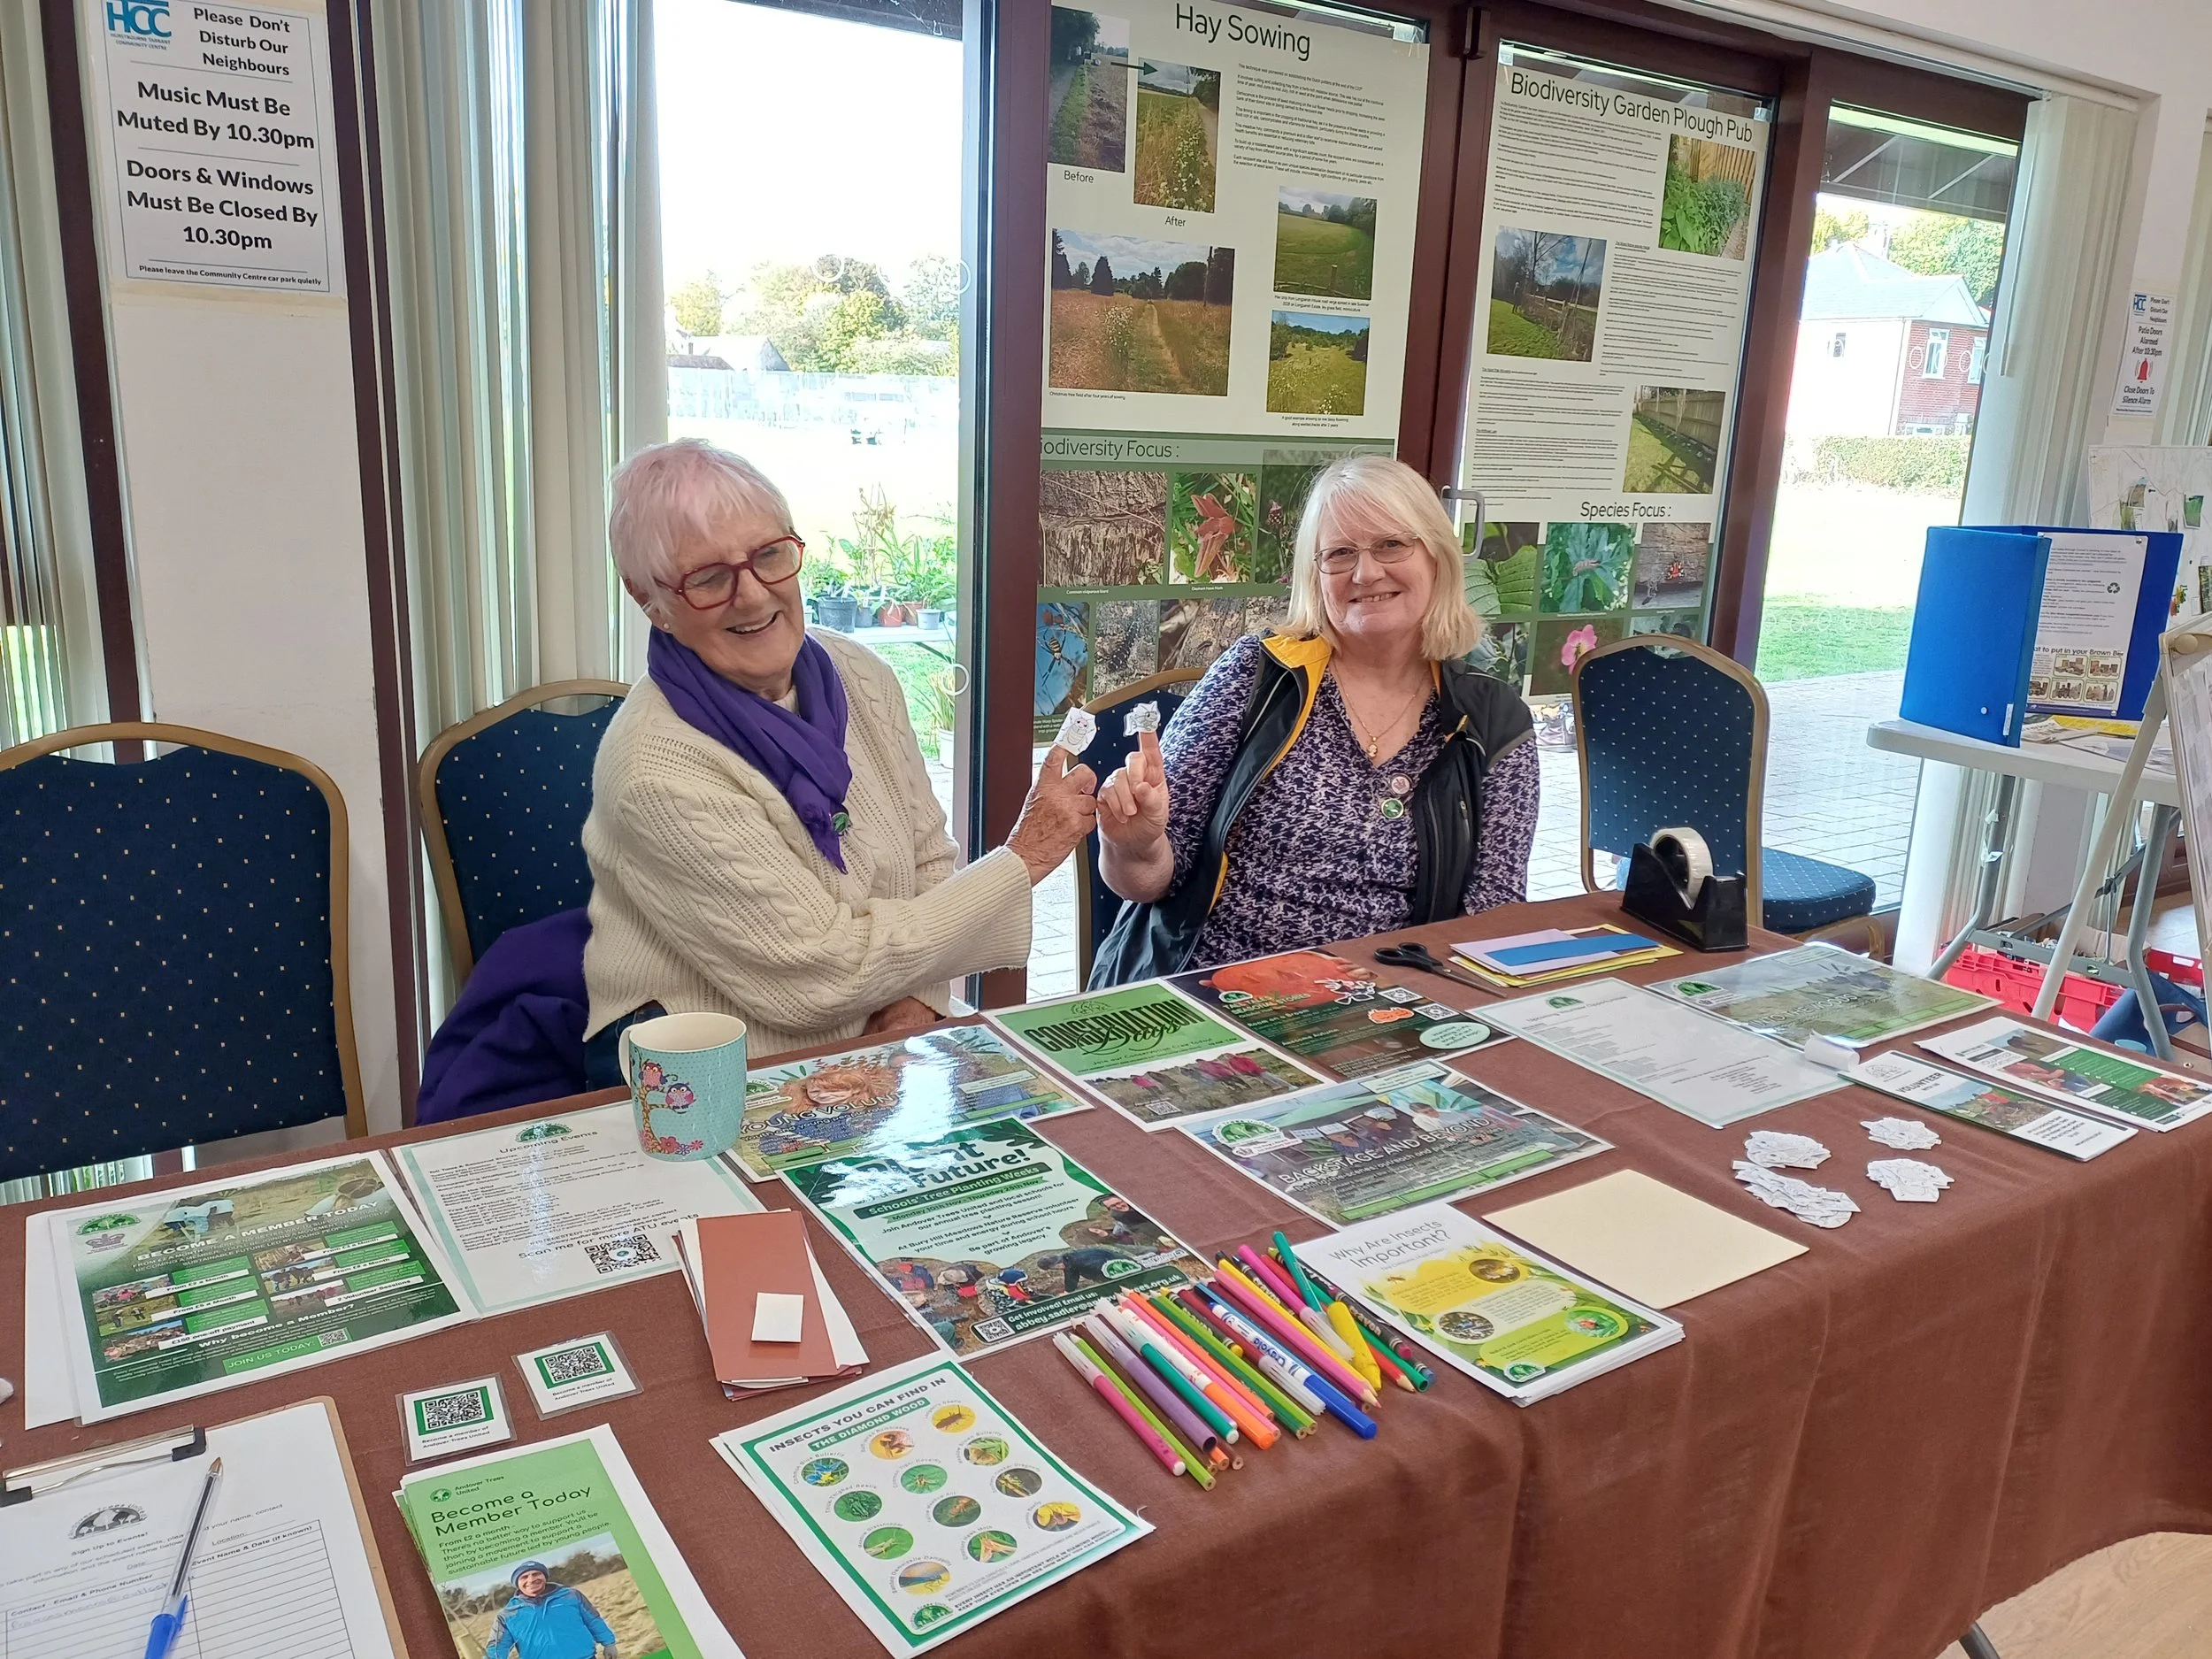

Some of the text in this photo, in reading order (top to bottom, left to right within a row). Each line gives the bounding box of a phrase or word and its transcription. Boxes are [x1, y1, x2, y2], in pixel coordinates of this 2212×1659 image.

[106, 1, 172, 37] HCC
[194, 6, 291, 33] Please Don't
[1176, 3, 1311, 61] Hay Sowing
[199, 31, 288, 54] Disturb Our
[203, 53, 290, 76] Neighbours
[137, 81, 291, 116] Music Must Be
[1510, 72, 1753, 142] Biodiversity Garden Plough Pub
[117, 111, 315, 149] Muted By 10.30pm
[127, 160, 314, 195] Doors & Windows
[1064, 170, 1094, 184] Before
[127, 190, 318, 227] Must Be Closed By
[1164, 216, 1187, 228] After
[183, 227, 273, 250] 10.30pm
[199, 270, 242, 280] Community
[280, 275, 296, 284] park
[1041, 437, 1123, 460] iodiversity
[1127, 441, 1172, 458] Focus
[1580, 502, 1630, 521] Species
[1632, 503, 1665, 517] Focus
[1024, 999, 1206, 1052] CONSERVATION
[1787, 1003, 1815, 1018] THE
[1895, 1071, 1946, 1094] VOLUNTEER
[740, 1110, 817, 1134] YOUNG
[500, 1132, 598, 1153] Upcoming Events
[1279, 1117, 1491, 1186] BACKSTAGE AND BEYOND
[868, 1167, 1041, 1215] Schools' Tree Planting Weeks
[882, 1225, 900, 1234] Join
[901, 1217, 935, 1229] Andover
[937, 1210, 959, 1219] Trees
[960, 1202, 989, 1214] United
[1003, 1194, 1021, 1202] local
[1023, 1186, 1052, 1197] schools
[910, 1238, 930, 1250] Bury
[931, 1234, 943, 1243] Hill
[944, 1225, 983, 1240] Meadows
[983, 1217, 1010, 1228] Nature
[1011, 1209, 1042, 1221] Reserve
[1043, 1197, 1079, 1212] volunteer
[137, 1237, 221, 1261] BECOME
[225, 1232, 237, 1241] A
[241, 1211, 320, 1239] MEMBER
[318, 1201, 380, 1220] TODAY
[518, 1247, 551, 1259] Scan
[599, 1230, 630, 1240] more
[633, 1223, 657, 1233] ATU
[1329, 1221, 1442, 1261] Why Are Insects
[1349, 1229, 1451, 1268] Important?
[198, 1338, 227, 1348] Why
[231, 1323, 283, 1340] become
[297, 1303, 354, 1322] Member?
[1008, 1313, 1024, 1323] Get
[1024, 1302, 1062, 1318] involved!
[1064, 1294, 1087, 1306] Email
[1348, 1304, 1382, 1337] crayon
[228, 1356, 254, 1368] JOIN
[1253, 1337, 1286, 1366] Crayola
[769, 1378, 947, 1452] INSECTS YOU CAN FIND IN
[811, 1400, 926, 1448] THE DIAMOND WOOD
[455, 1481, 483, 1491] Andover
[456, 1486, 480, 1495] United
[432, 1494, 514, 1524] Become
[435, 1487, 591, 1536] Member Today
[117, 1532, 148, 1544] Events!
[442, 1543, 472, 1555] There's
[487, 1532, 512, 1542] better
[514, 1527, 530, 1536] way
[542, 1514, 575, 1528] support
